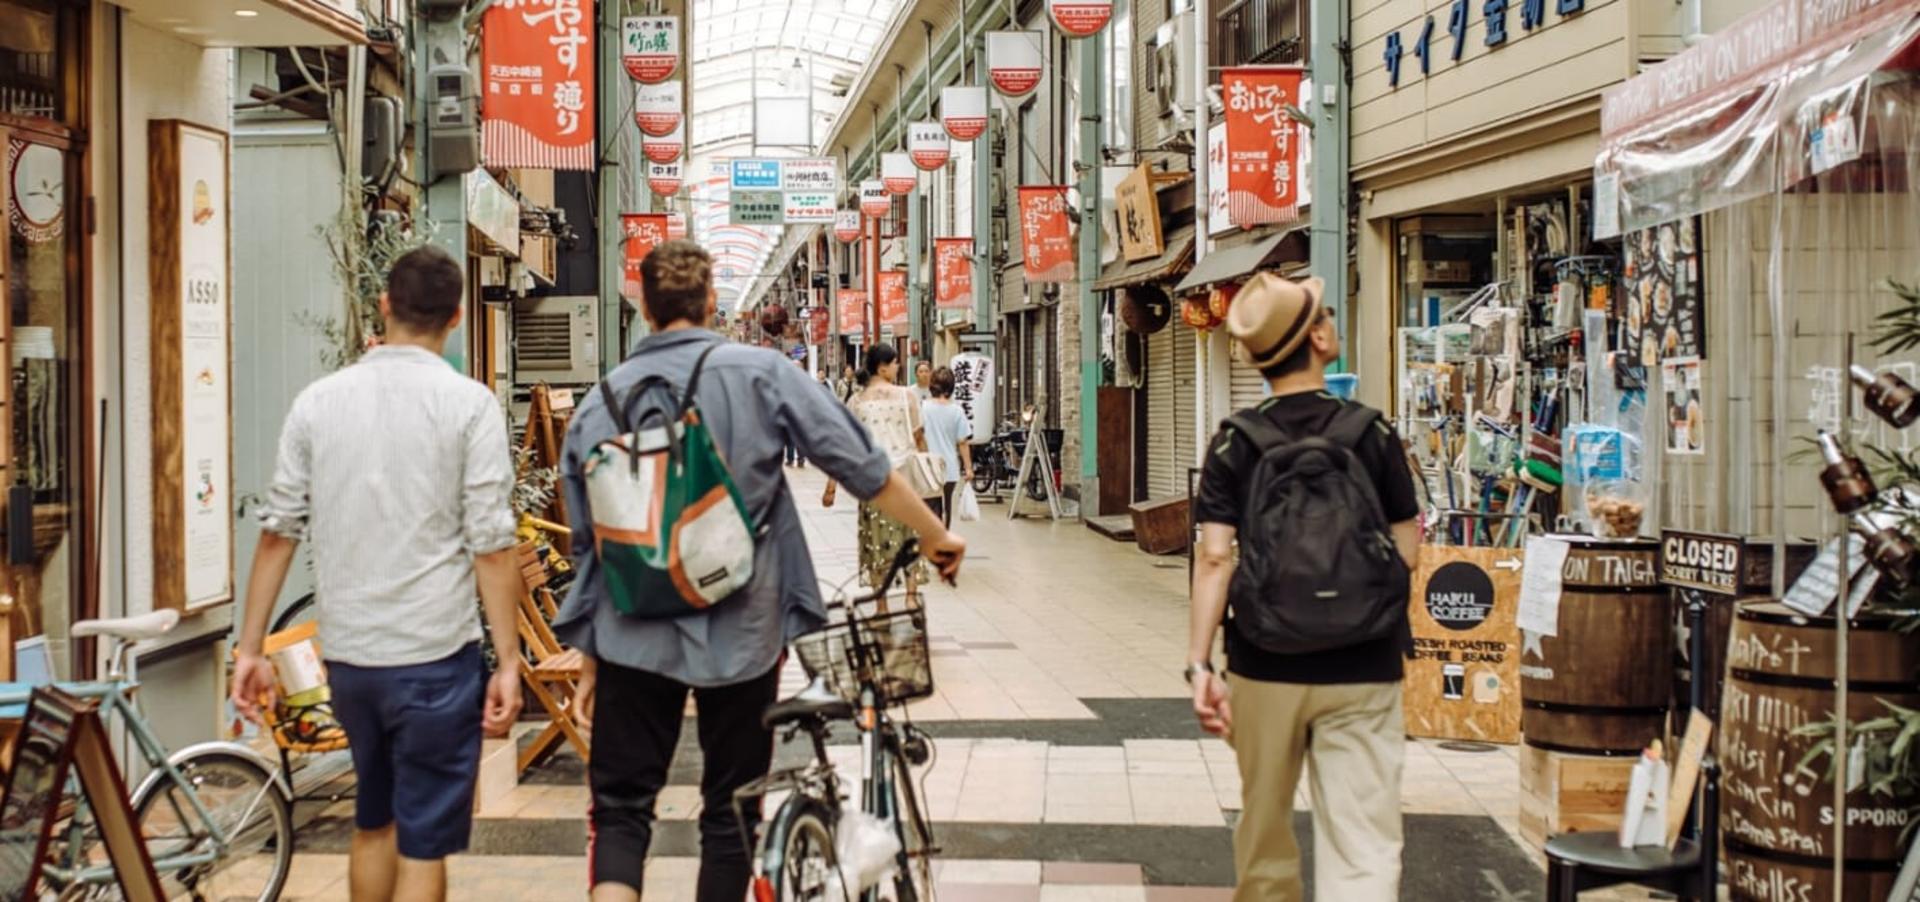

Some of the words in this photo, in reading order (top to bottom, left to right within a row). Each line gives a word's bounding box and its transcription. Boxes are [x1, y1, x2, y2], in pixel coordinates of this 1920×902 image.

[1714, 36, 1741, 82] ON
[652, 166, 678, 176] 中村
[187, 279, 219, 305] ASSO
[1665, 537, 1738, 571] CLOSED
[1564, 556, 1590, 582] ON
[1430, 592, 1475, 606] HAIKU
[1431, 606, 1486, 620] COFFEE
[1448, 640, 1508, 654] ROASTED
[1462, 652, 1504, 664] BEANS
[1819, 806, 1908, 826] SPPORO
